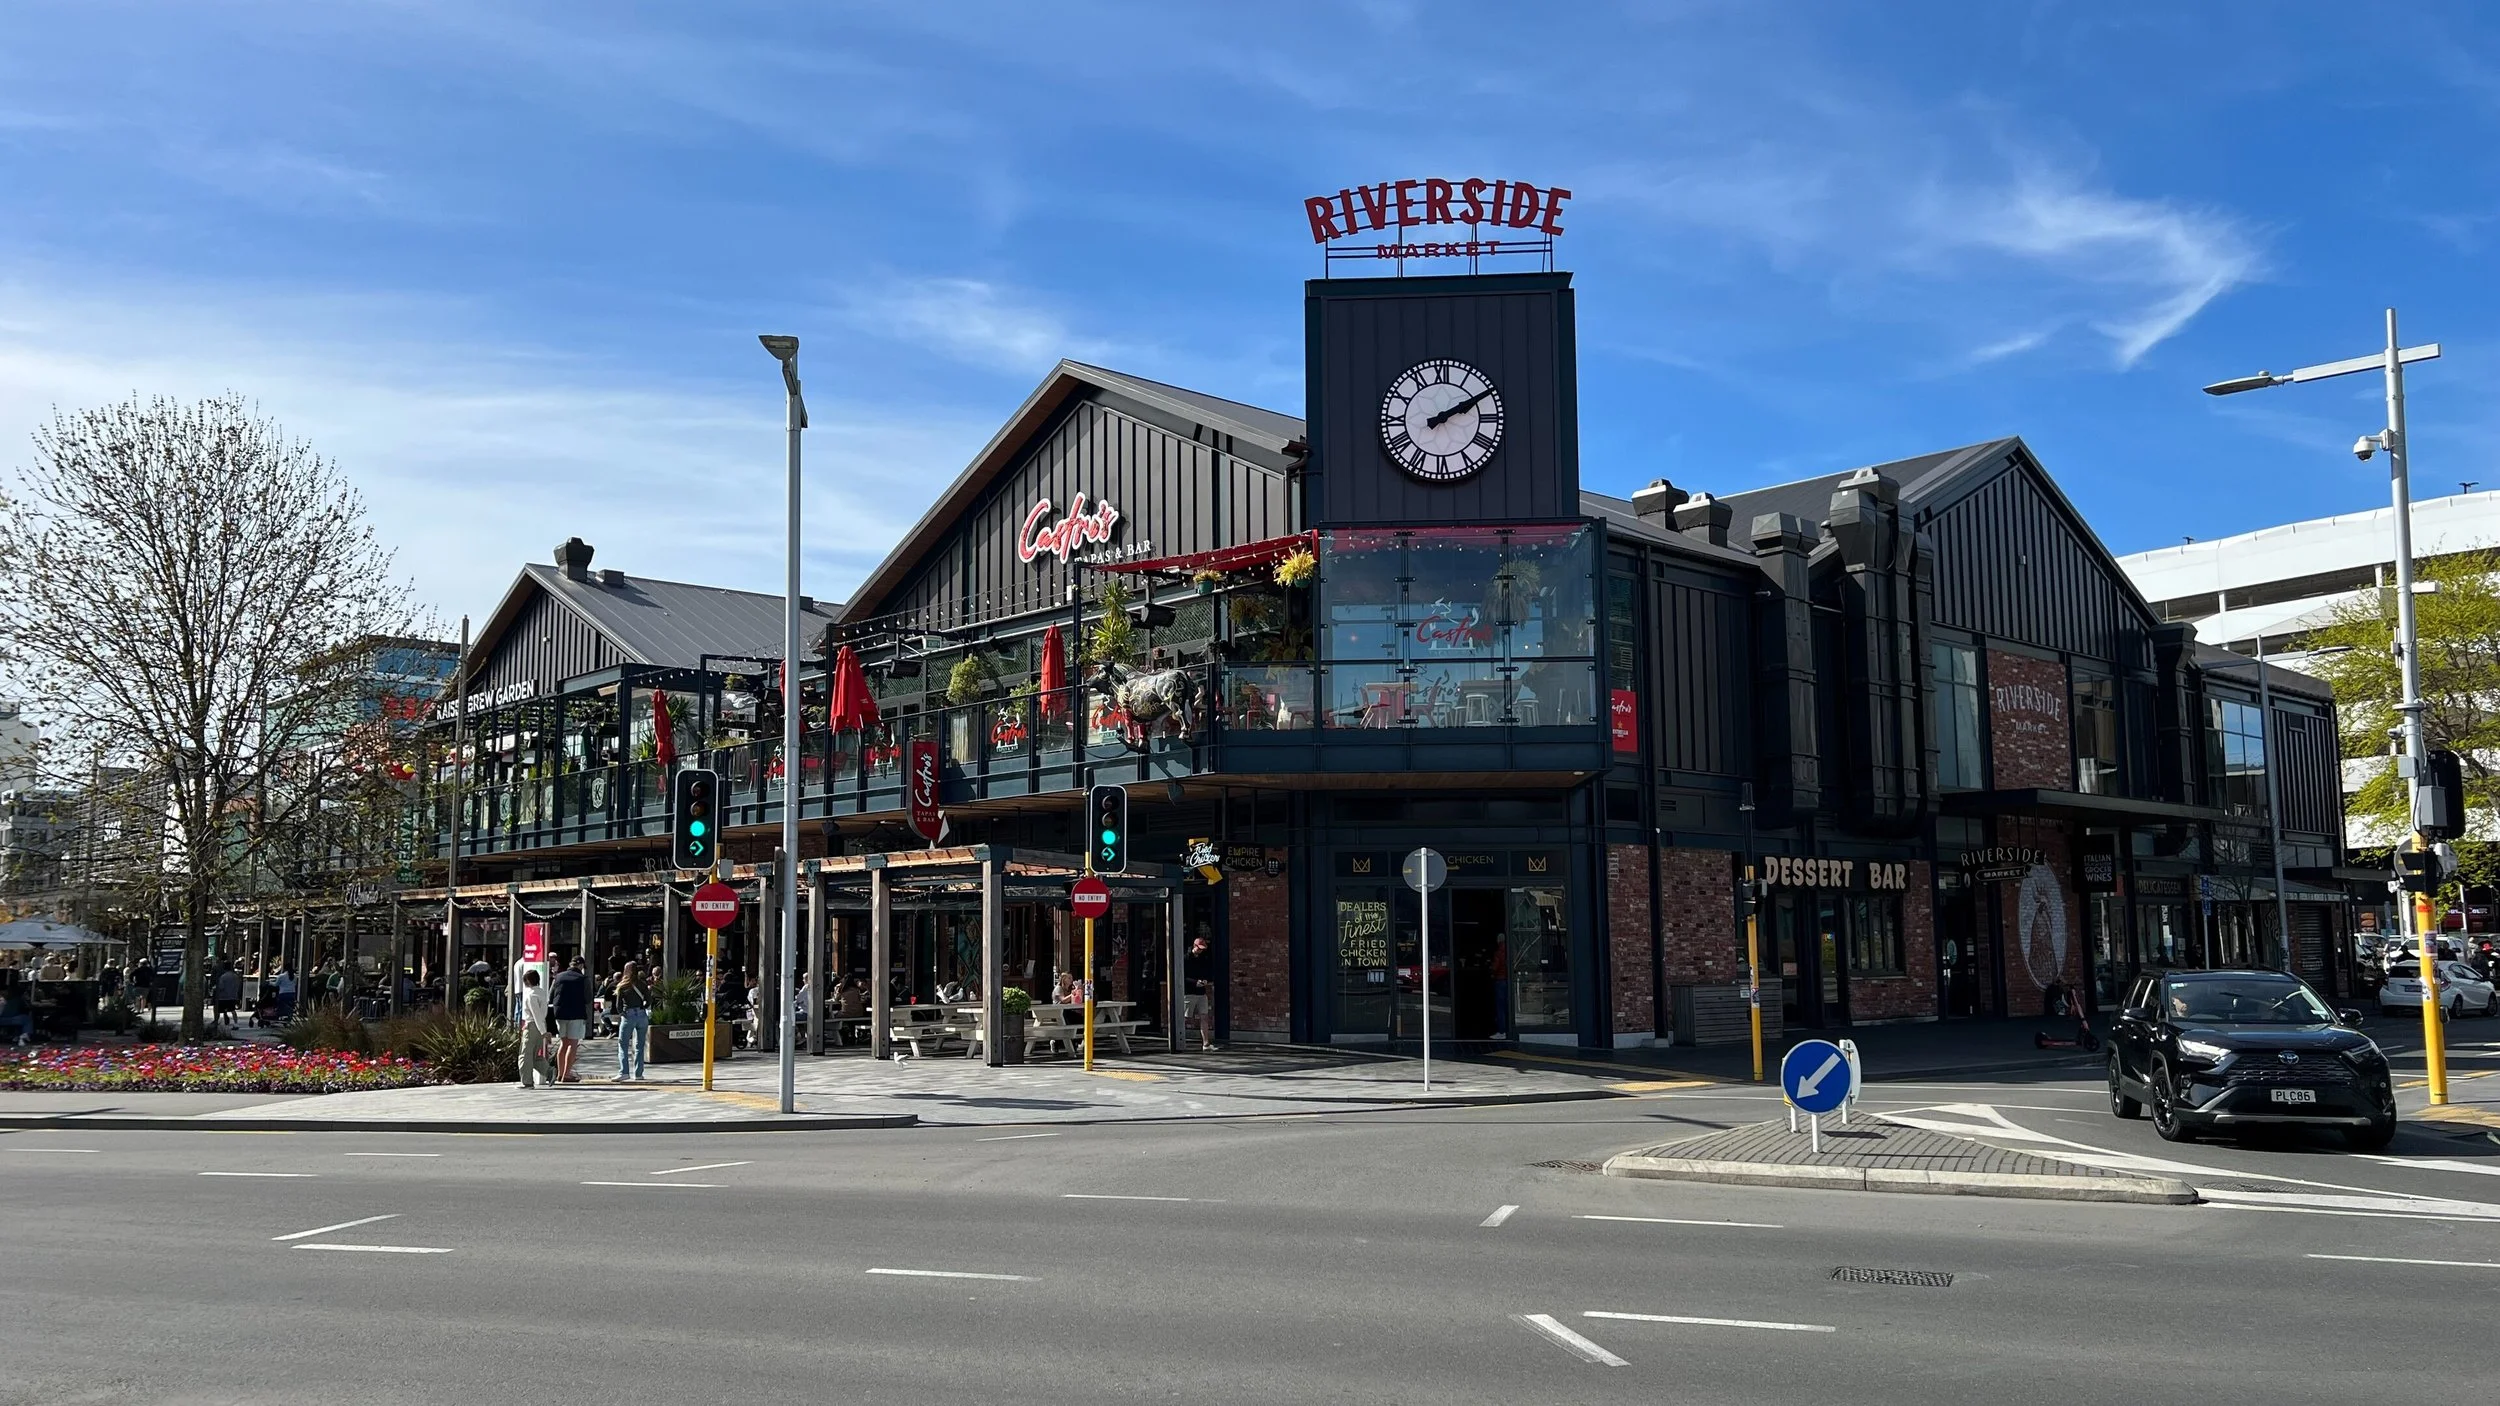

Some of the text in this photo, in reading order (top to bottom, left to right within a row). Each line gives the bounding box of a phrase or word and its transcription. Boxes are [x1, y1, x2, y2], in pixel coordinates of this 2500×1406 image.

[1304, 178, 1572, 245] RIVERSIDE
[1376, 240, 1501, 259] MARKET
[1018, 491, 1119, 564] Castro's
[1115, 546, 1123, 559] &
[1126, 540, 1151, 556] BAR
[436, 679, 534, 720] KAIS BREW GARDEN
[1996, 685, 2062, 722] RIVERSIDE
[914, 752, 936, 807] Castro's
[1227, 846, 1260, 857] EMPIRE
[1960, 846, 2041, 867] RIVERSIDE
[2083, 853, 2112, 863] ITALIAN
[1189, 851, 1221, 867] Chicken
[1225, 857, 1263, 867] CHICKEN
[1447, 855, 1494, 865] CHICKEN
[1764, 856, 1907, 890] DESSERT BAR
[1983, 870, 2021, 879] MARKET
[2084, 873, 2113, 883] WINES
[1339, 901, 1387, 912] DEALERS
[1339, 915, 1387, 944] finest
[1350, 939, 1387, 949] FRIED
[1340, 948, 1387, 958] CHICKEN
[1341, 958, 1387, 967] IN TOWN
[2275, 1090, 2311, 1101] PLC86
